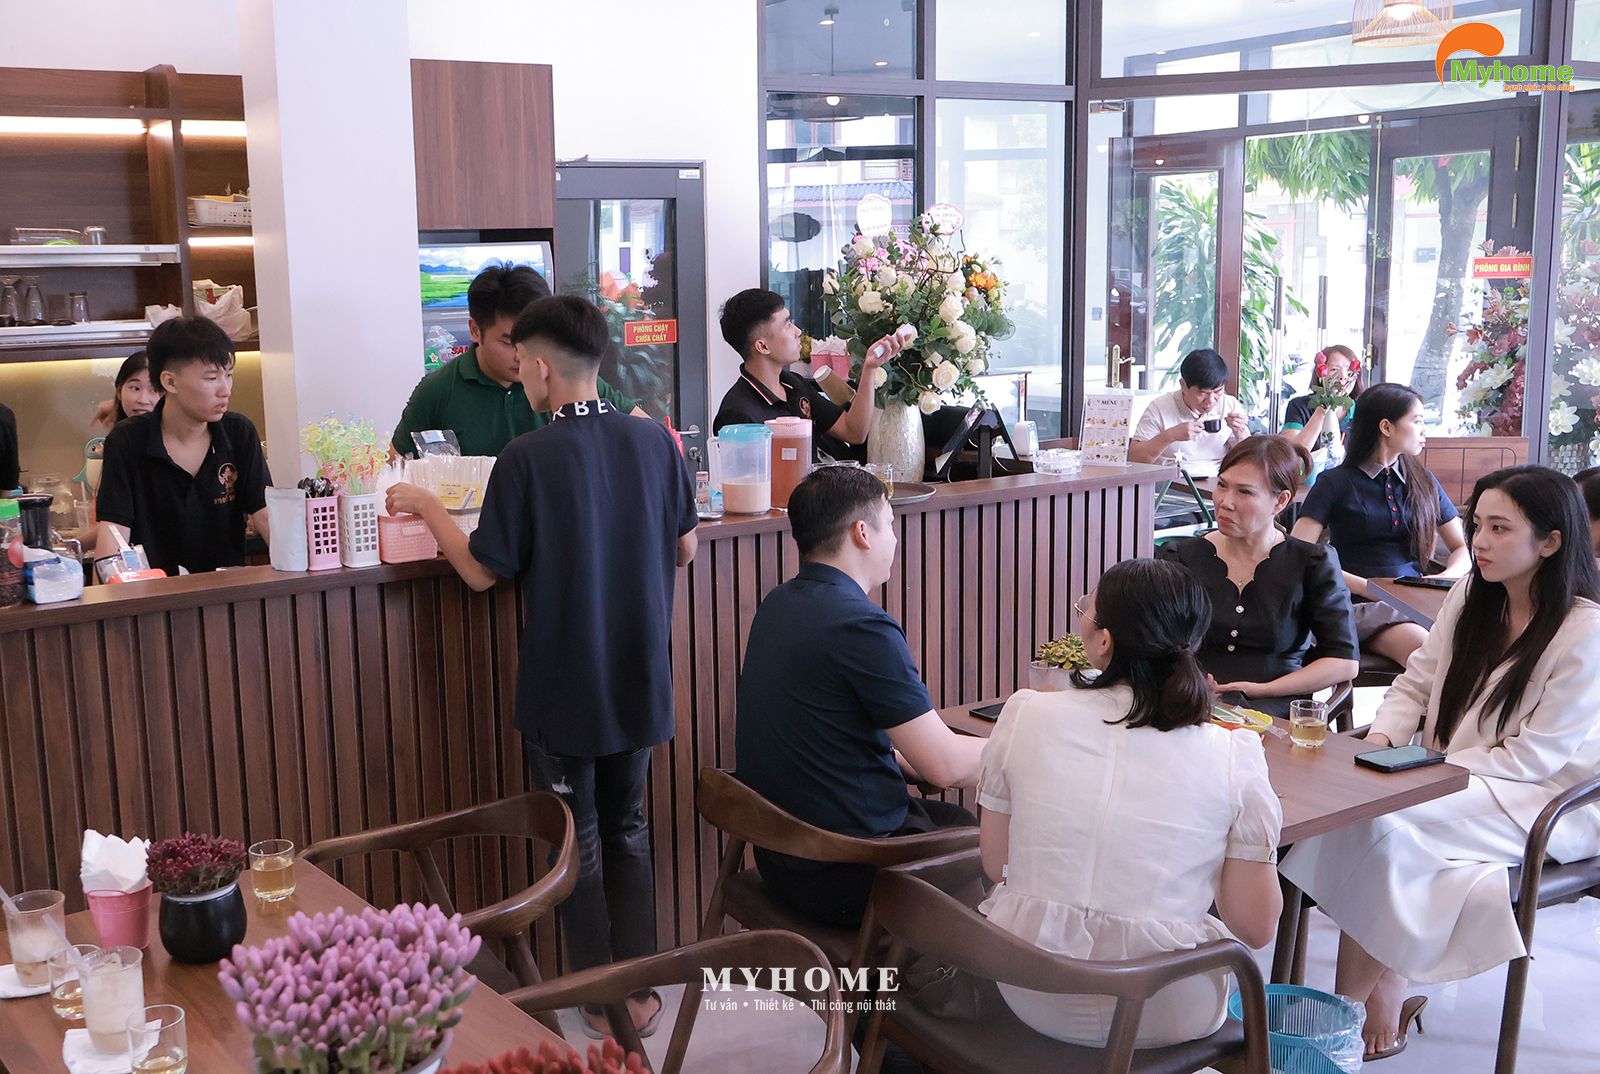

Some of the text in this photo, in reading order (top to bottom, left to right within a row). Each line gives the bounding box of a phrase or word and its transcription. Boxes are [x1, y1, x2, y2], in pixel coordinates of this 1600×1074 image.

[1475, 262, 1531, 272] PHÒNG GIA ĐÌNH
[633, 324, 653, 333] PHÒNG
[652, 332, 667, 341] CHÁY
